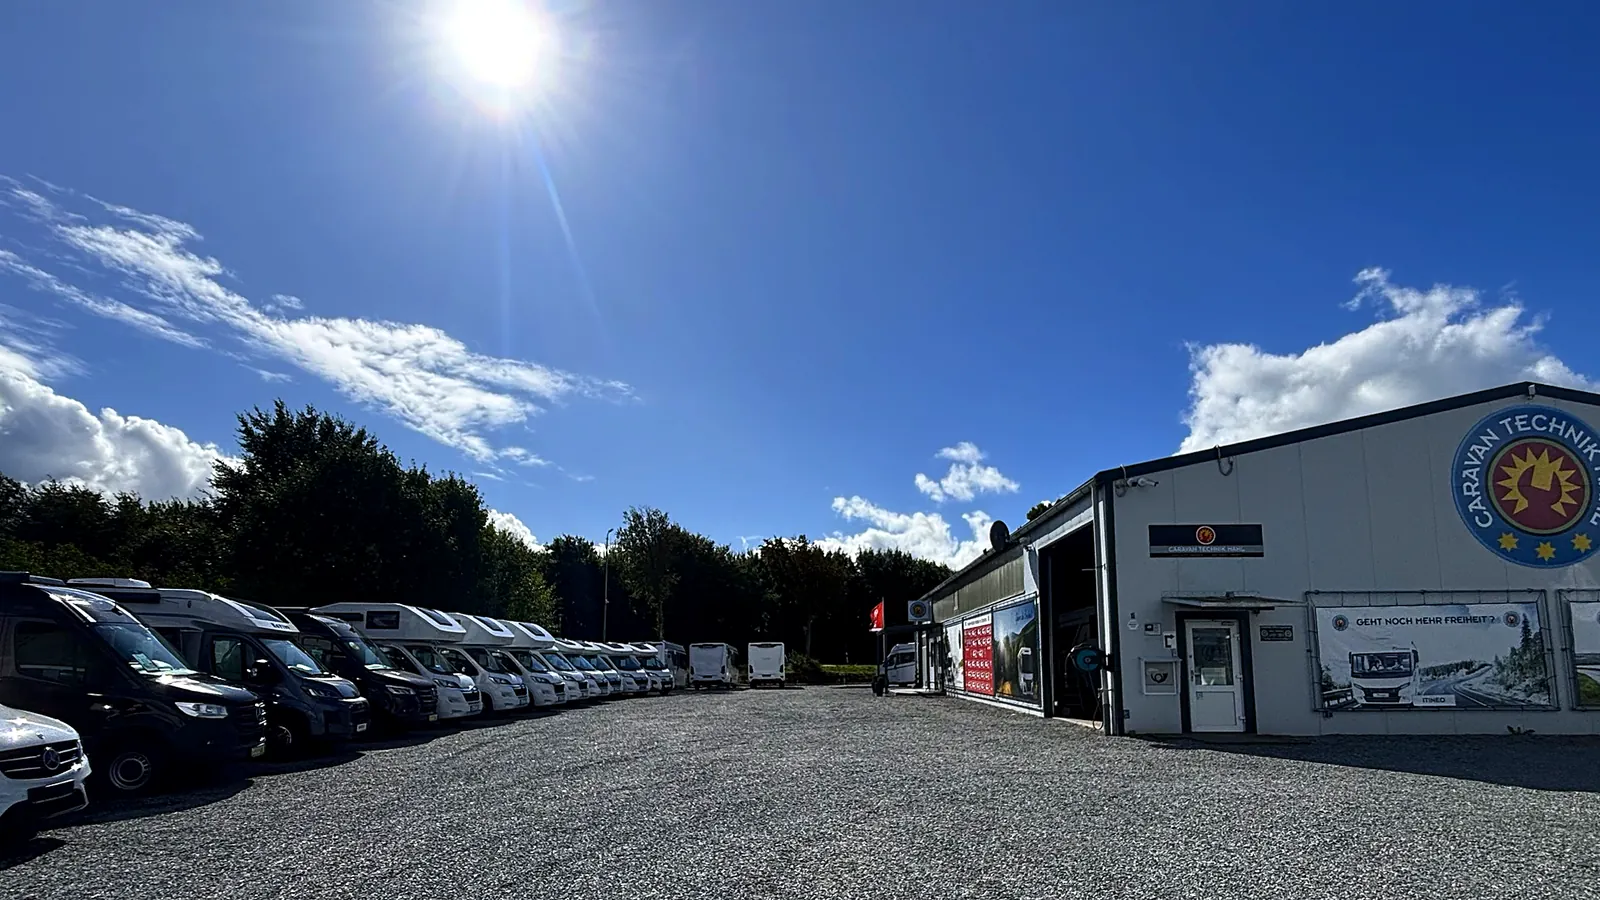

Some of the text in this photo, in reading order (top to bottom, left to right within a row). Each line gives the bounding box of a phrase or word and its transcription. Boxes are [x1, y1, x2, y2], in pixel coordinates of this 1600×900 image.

[1462, 414, 1600, 529] CARAVAN TECHNIK
[1168, 545, 1198, 553] CARAVAN
[1198, 545, 1227, 553] TECHNIK
[1356, 618, 1382, 626] GEHT
[1384, 617, 1413, 626] NOCH
[1415, 616, 1443, 625] MEHR
[1444, 615, 1488, 624] FREIHEIT
